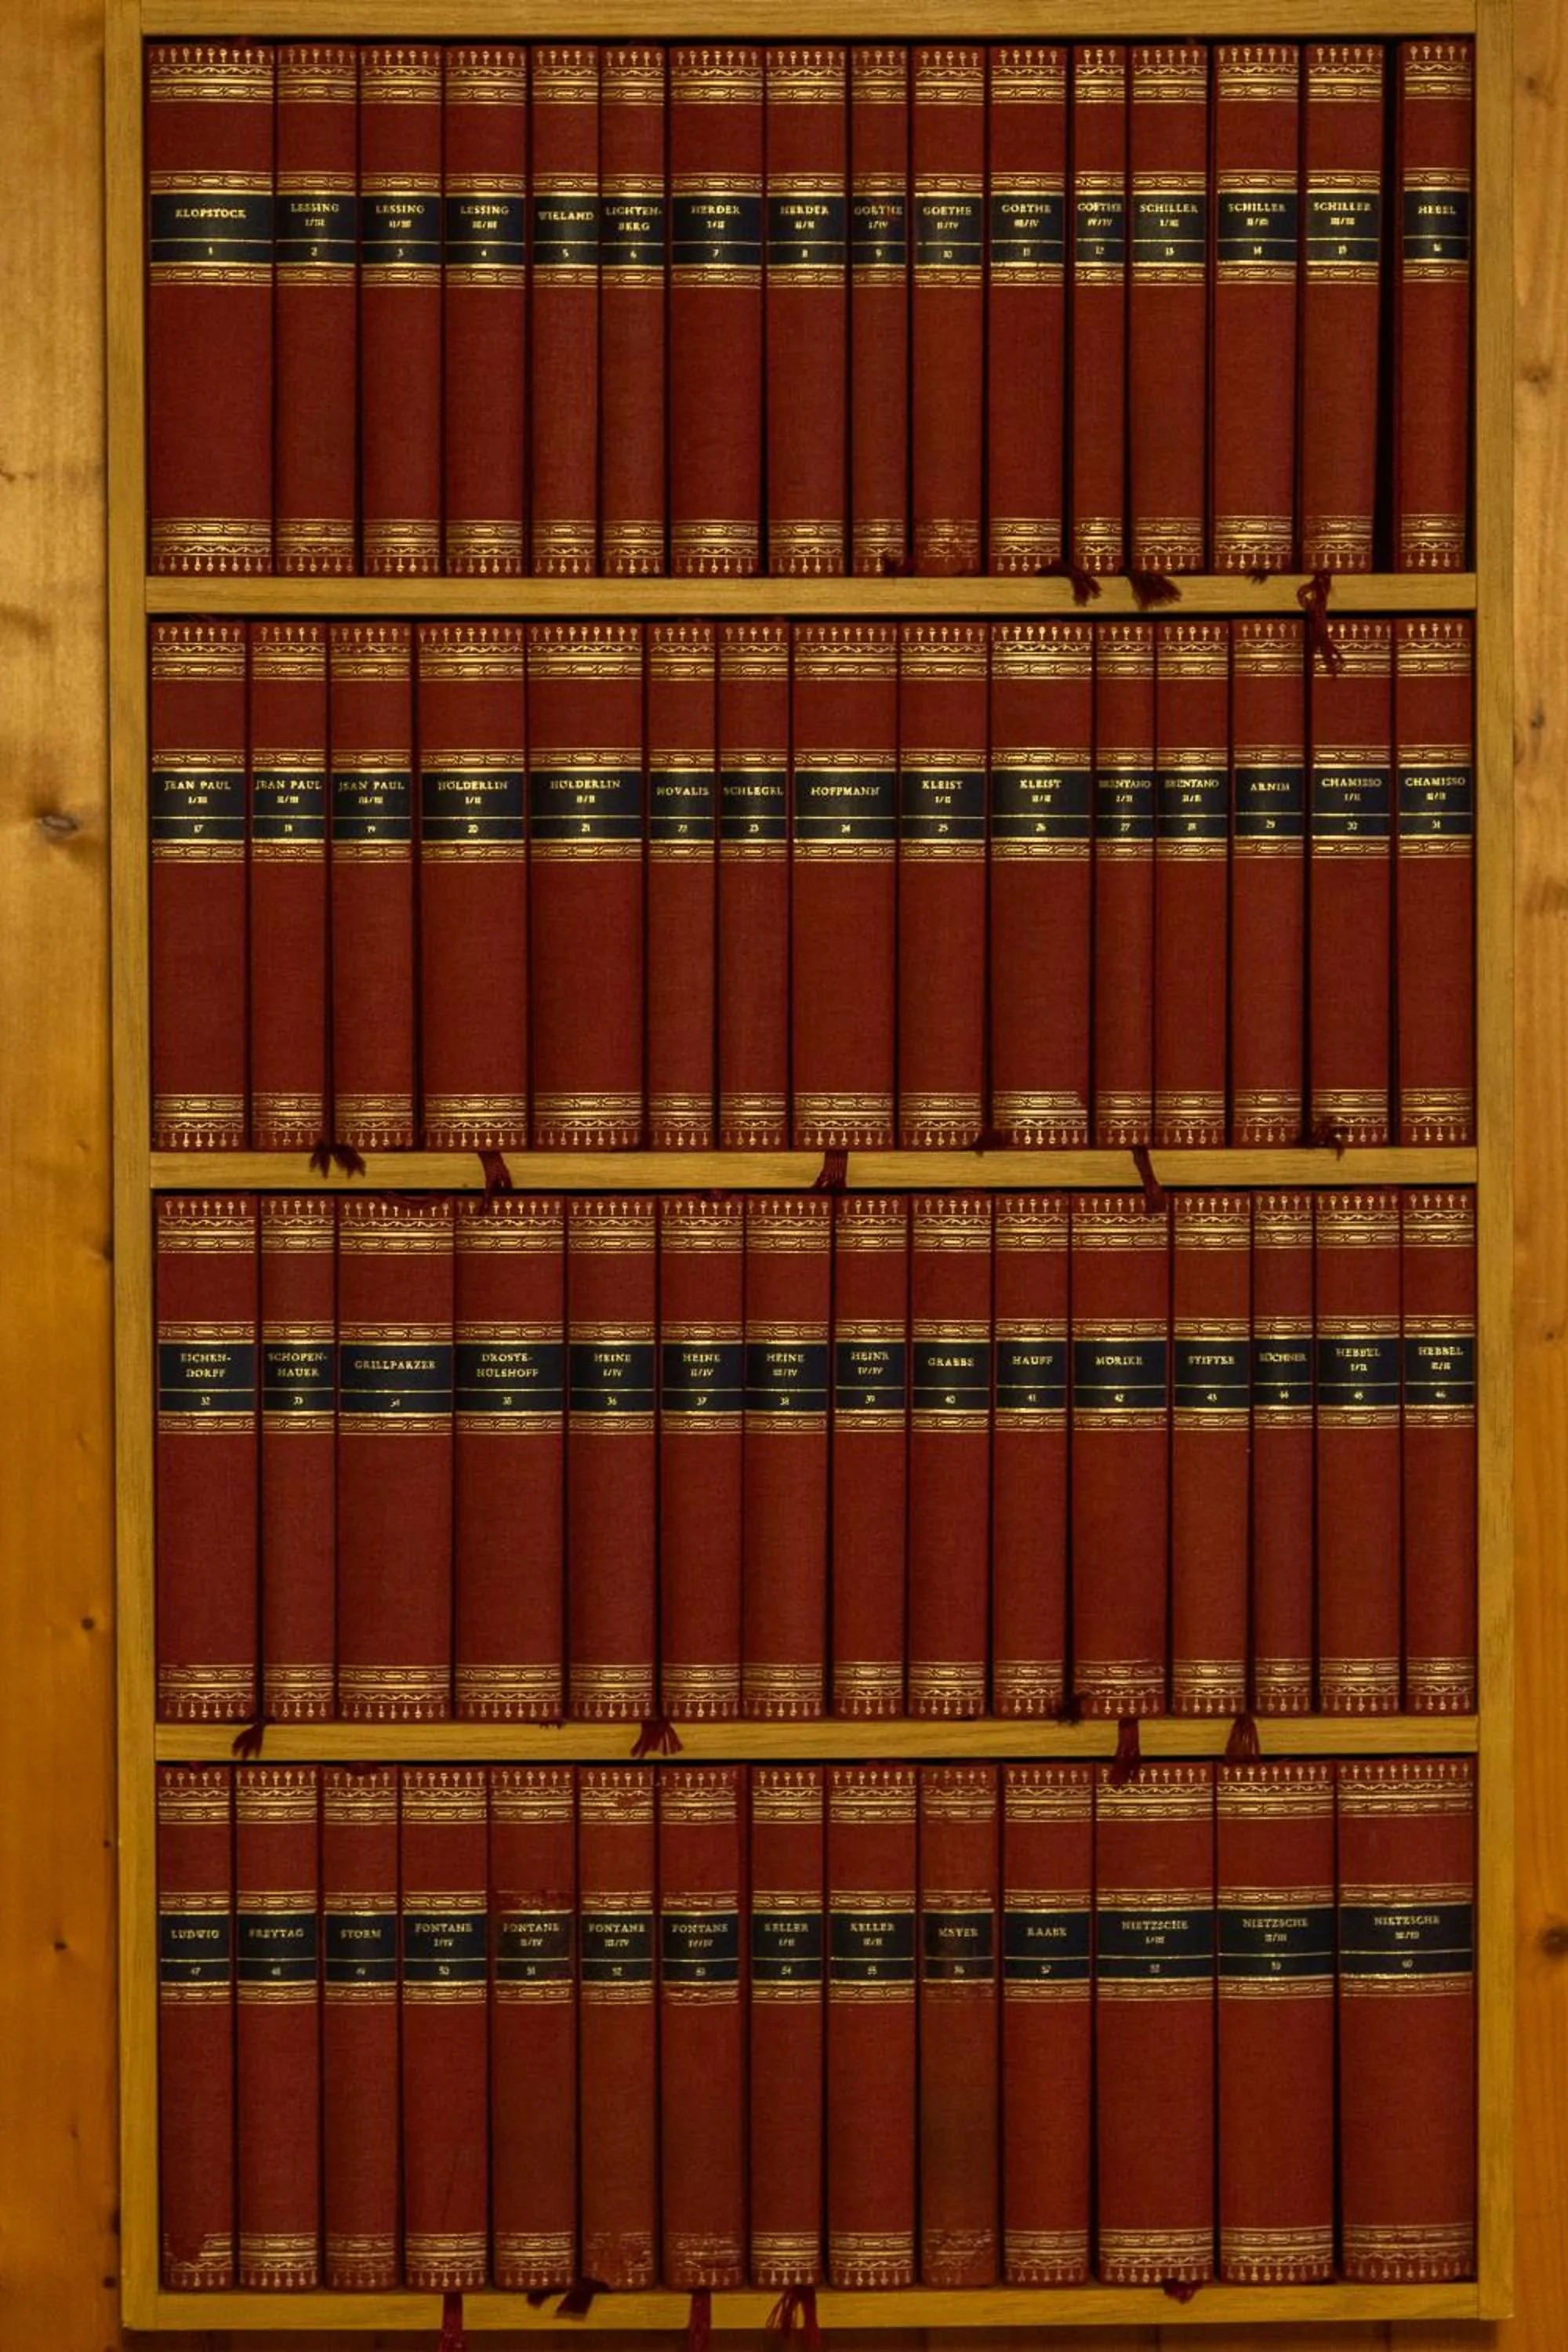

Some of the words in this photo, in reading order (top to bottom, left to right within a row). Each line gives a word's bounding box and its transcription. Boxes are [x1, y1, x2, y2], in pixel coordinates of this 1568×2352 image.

[291, 202, 339, 213] LESSING
[376, 203, 425, 214] LESSING
[460, 204, 510, 216] LESSING
[606, 205, 662, 216] LICHTEN-
[780, 204, 829, 216] HERDER
[854, 205, 902, 216] GOETHE
[923, 205, 972, 216] GOETHE
[1001, 203, 1051, 214] GOETHE
[1077, 201, 1122, 214] GOETHE
[1139, 202, 1199, 213] SCHILLER
[1229, 201, 1285, 213] SCHILLER
[1313, 201, 1371, 212] SCHILLER
[1417, 205, 1456, 216] HEBEL
[175, 208, 246, 220] KLOPSTOCK
[539, 211, 594, 221] WIELAND
[921, 779, 964, 790] KLEIST
[1019, 779, 1062, 790] KLEIST
[1250, 782, 1290, 792] ARNIM
[1321, 777, 1382, 788] CHAMISSO
[1404, 777, 1466, 787] CHAMISSO
[656, 786, 710, 797] NOVALIS
[724, 786, 784, 797] SCHLEGEL
[810, 786, 880, 797] HOFFMANN
[1336, 1347, 1381, 1358] HEBBEL
[1418, 1345, 1463, 1356] HEBBEL
[180, 1352, 231, 1363] EICHEN-
[481, 1352, 532, 1363] DROSTE-
[594, 1352, 631, 1363] HEINE
[683, 1352, 720, 1363] HEINE
[767, 1352, 804, 1363] HEINE
[851, 1351, 890, 1362] HEINE
[927, 1357, 975, 1367] GRABBE
[1012, 1356, 1053, 1366] HAUFF
[354, 1359, 436, 1370] GRILLPARZER
[186, 1368, 225, 1378] DORFF
[278, 1367, 319, 1377] HAUER
[1122, 1919, 1189, 1931] NIETZSCHE
[1243, 1918, 1307, 1929] NIETZSCHE
[1374, 1915, 1439, 1926] NIETZSCHE
[416, 1922, 473, 1933] FONTANE
[503, 1922, 560, 1933] FONTANE
[589, 1923, 645, 1933] FONTANE
[850, 1922, 895, 1933] KELLER
[1027, 1927, 1067, 1937] RAABE
[172, 1929, 220, 1939] LUDWIG
[342, 1929, 381, 1939] STORM
